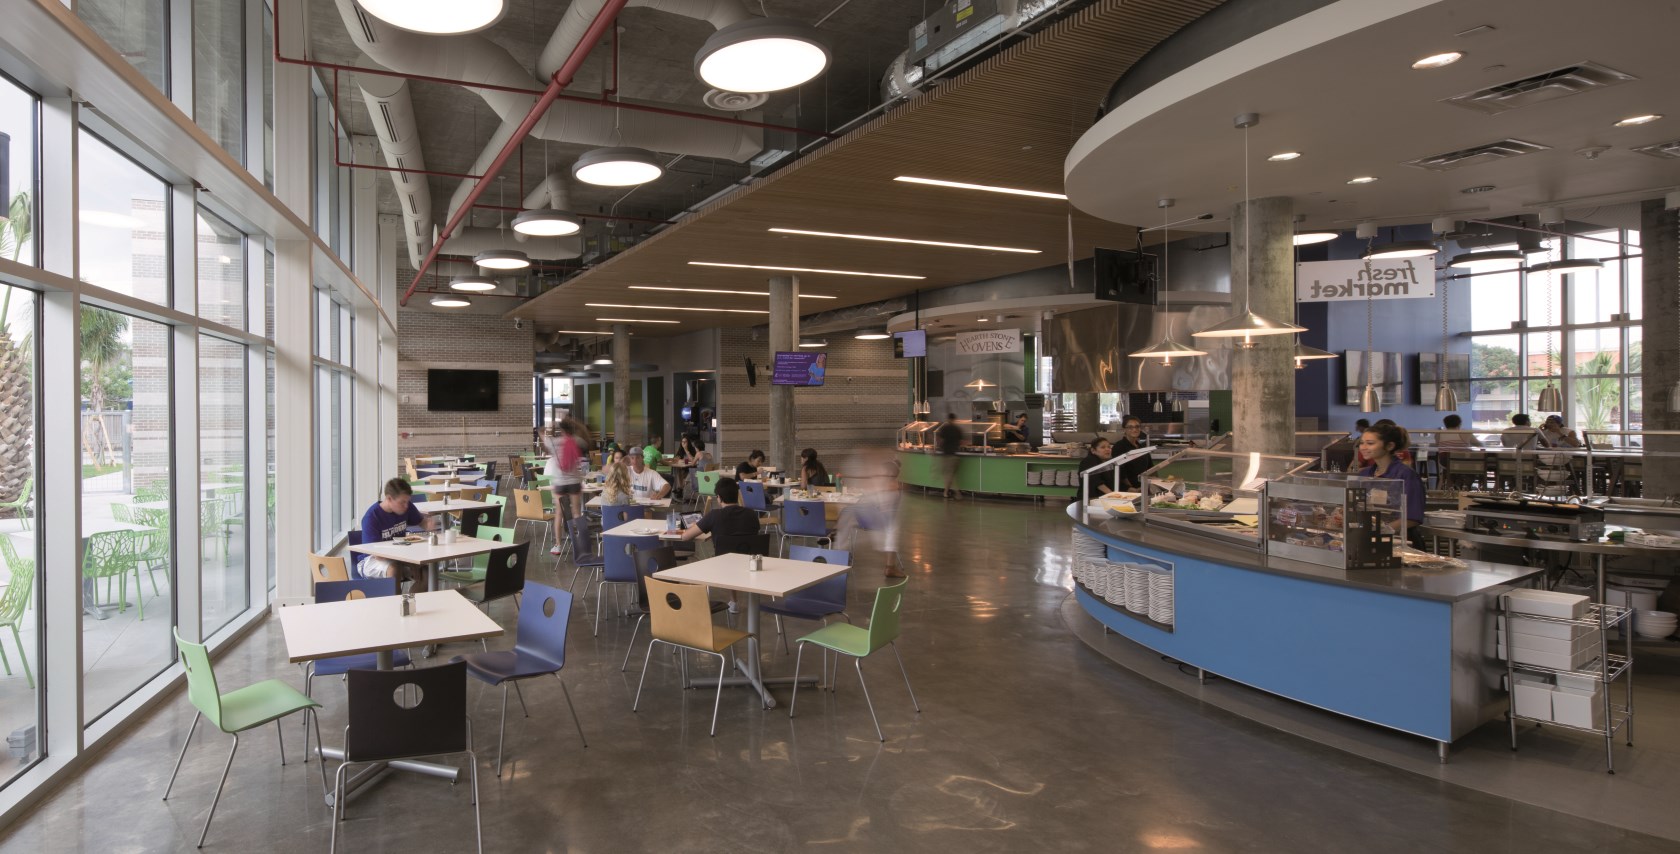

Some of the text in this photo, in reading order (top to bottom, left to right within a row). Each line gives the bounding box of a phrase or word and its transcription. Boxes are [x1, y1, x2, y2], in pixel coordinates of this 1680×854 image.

[959, 333, 1015, 353] HEARTH STONE
[971, 341, 1004, 353] OVENS
